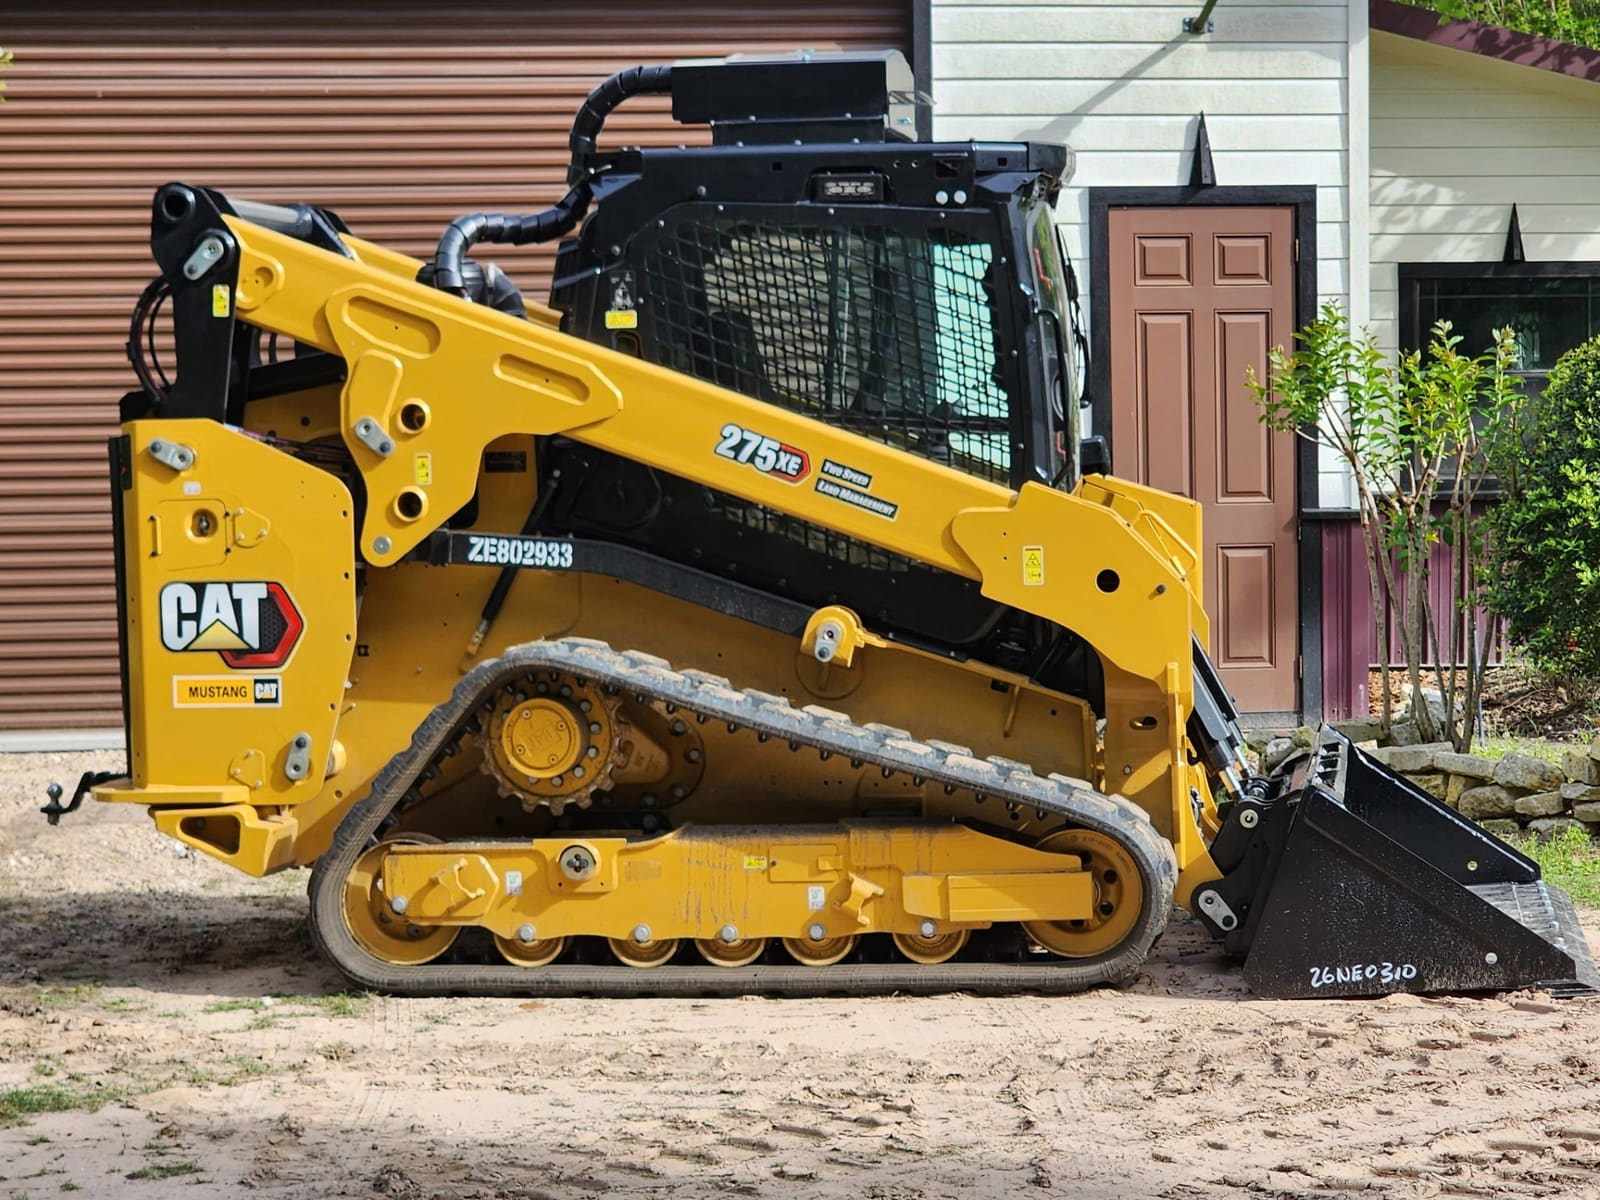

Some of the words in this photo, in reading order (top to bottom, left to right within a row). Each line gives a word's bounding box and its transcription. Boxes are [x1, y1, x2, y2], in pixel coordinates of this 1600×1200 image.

[467, 536, 573, 568] ZE802933
[160, 583, 268, 650] CAT
[188, 686, 248, 698] MUSTANG
[255, 683, 277, 699] CAT
